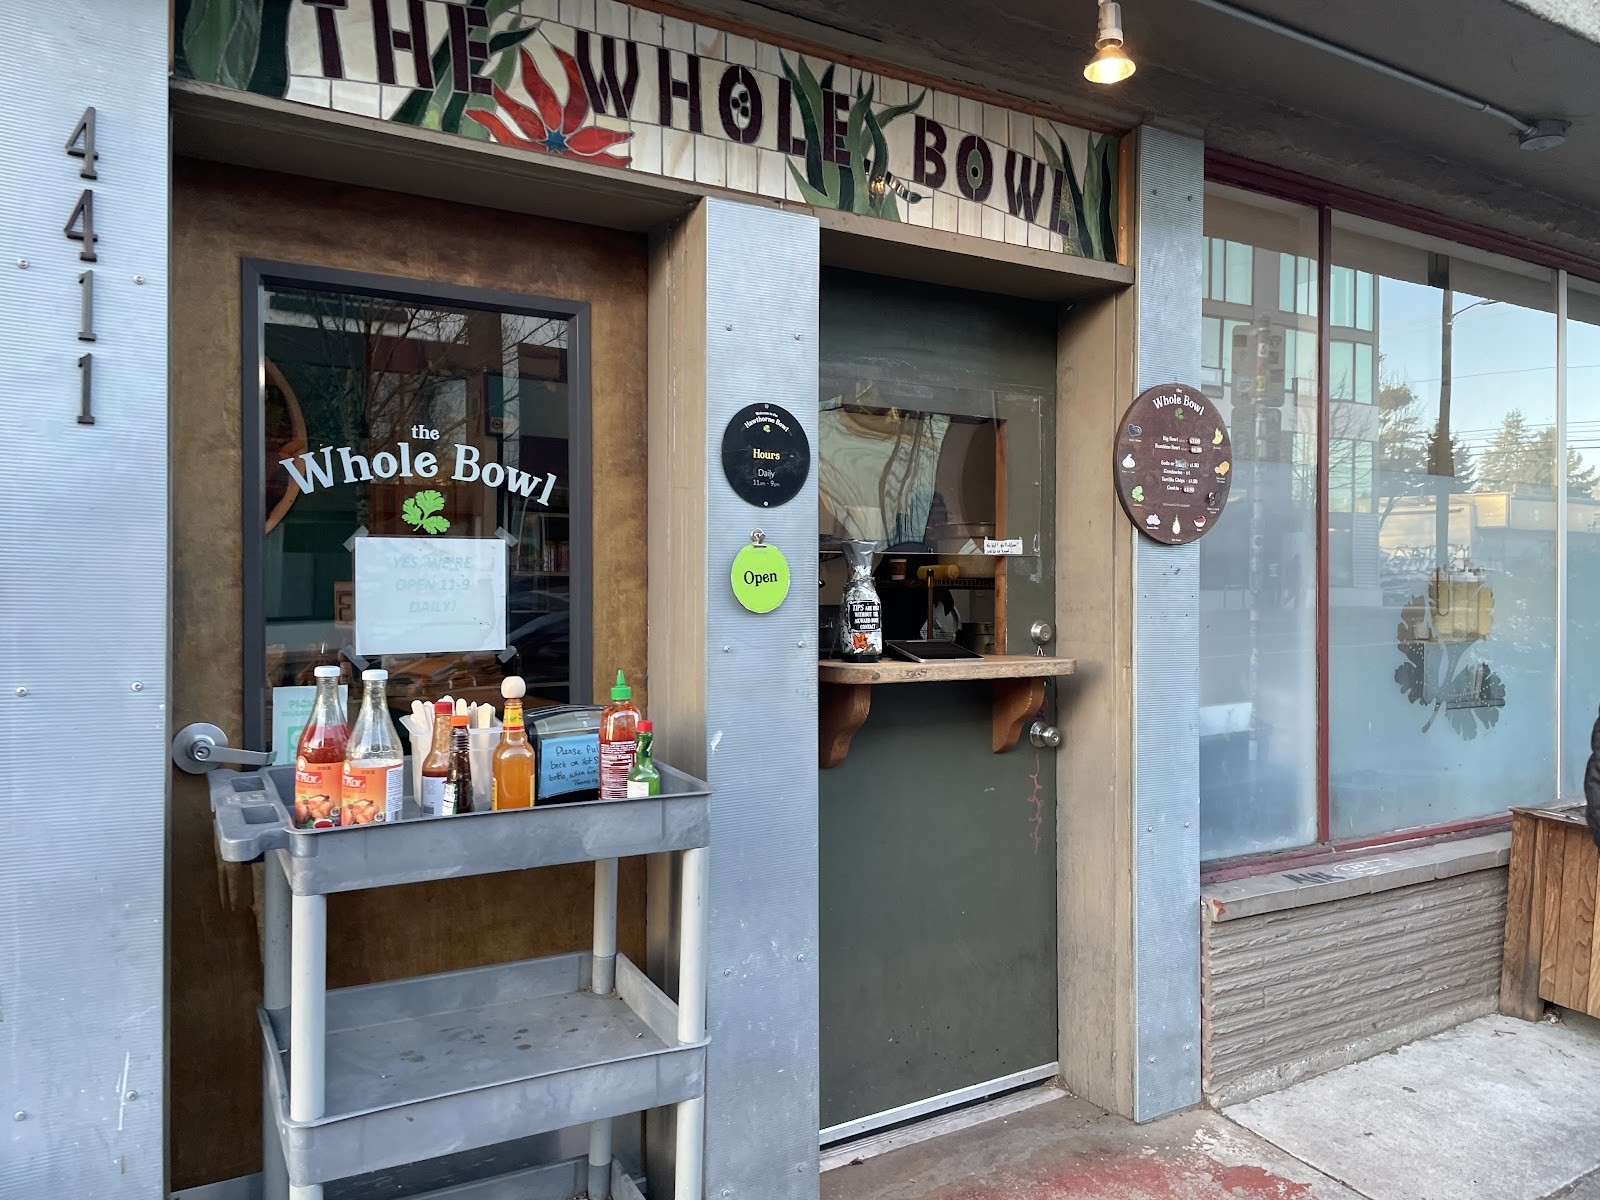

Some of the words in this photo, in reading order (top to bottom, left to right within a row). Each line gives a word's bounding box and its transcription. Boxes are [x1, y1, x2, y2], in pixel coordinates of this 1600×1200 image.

[301, 0, 494, 96] THE
[575, 28, 851, 168] WHOLE
[913, 113, 1070, 237] BOWL
[64, 105, 99, 425] 4411
[1152, 393, 1182, 410] Whole
[1183, 394, 1206, 416] Bowl
[411, 424, 440, 440] the
[743, 416, 775, 429] Hawthorne
[775, 418, 790, 432] Bowl
[753, 448, 781, 460] Hours
[279, 442, 439, 495] Whole
[451, 443, 557, 506] Bowl
[758, 468, 775, 480] Daily
[394, 578, 436, 591] OPEN
[743, 570, 778, 587] Open
[555, 745, 582, 756] Please
[550, 761, 567, 770] back
[582, 757, 592, 766] Hot
